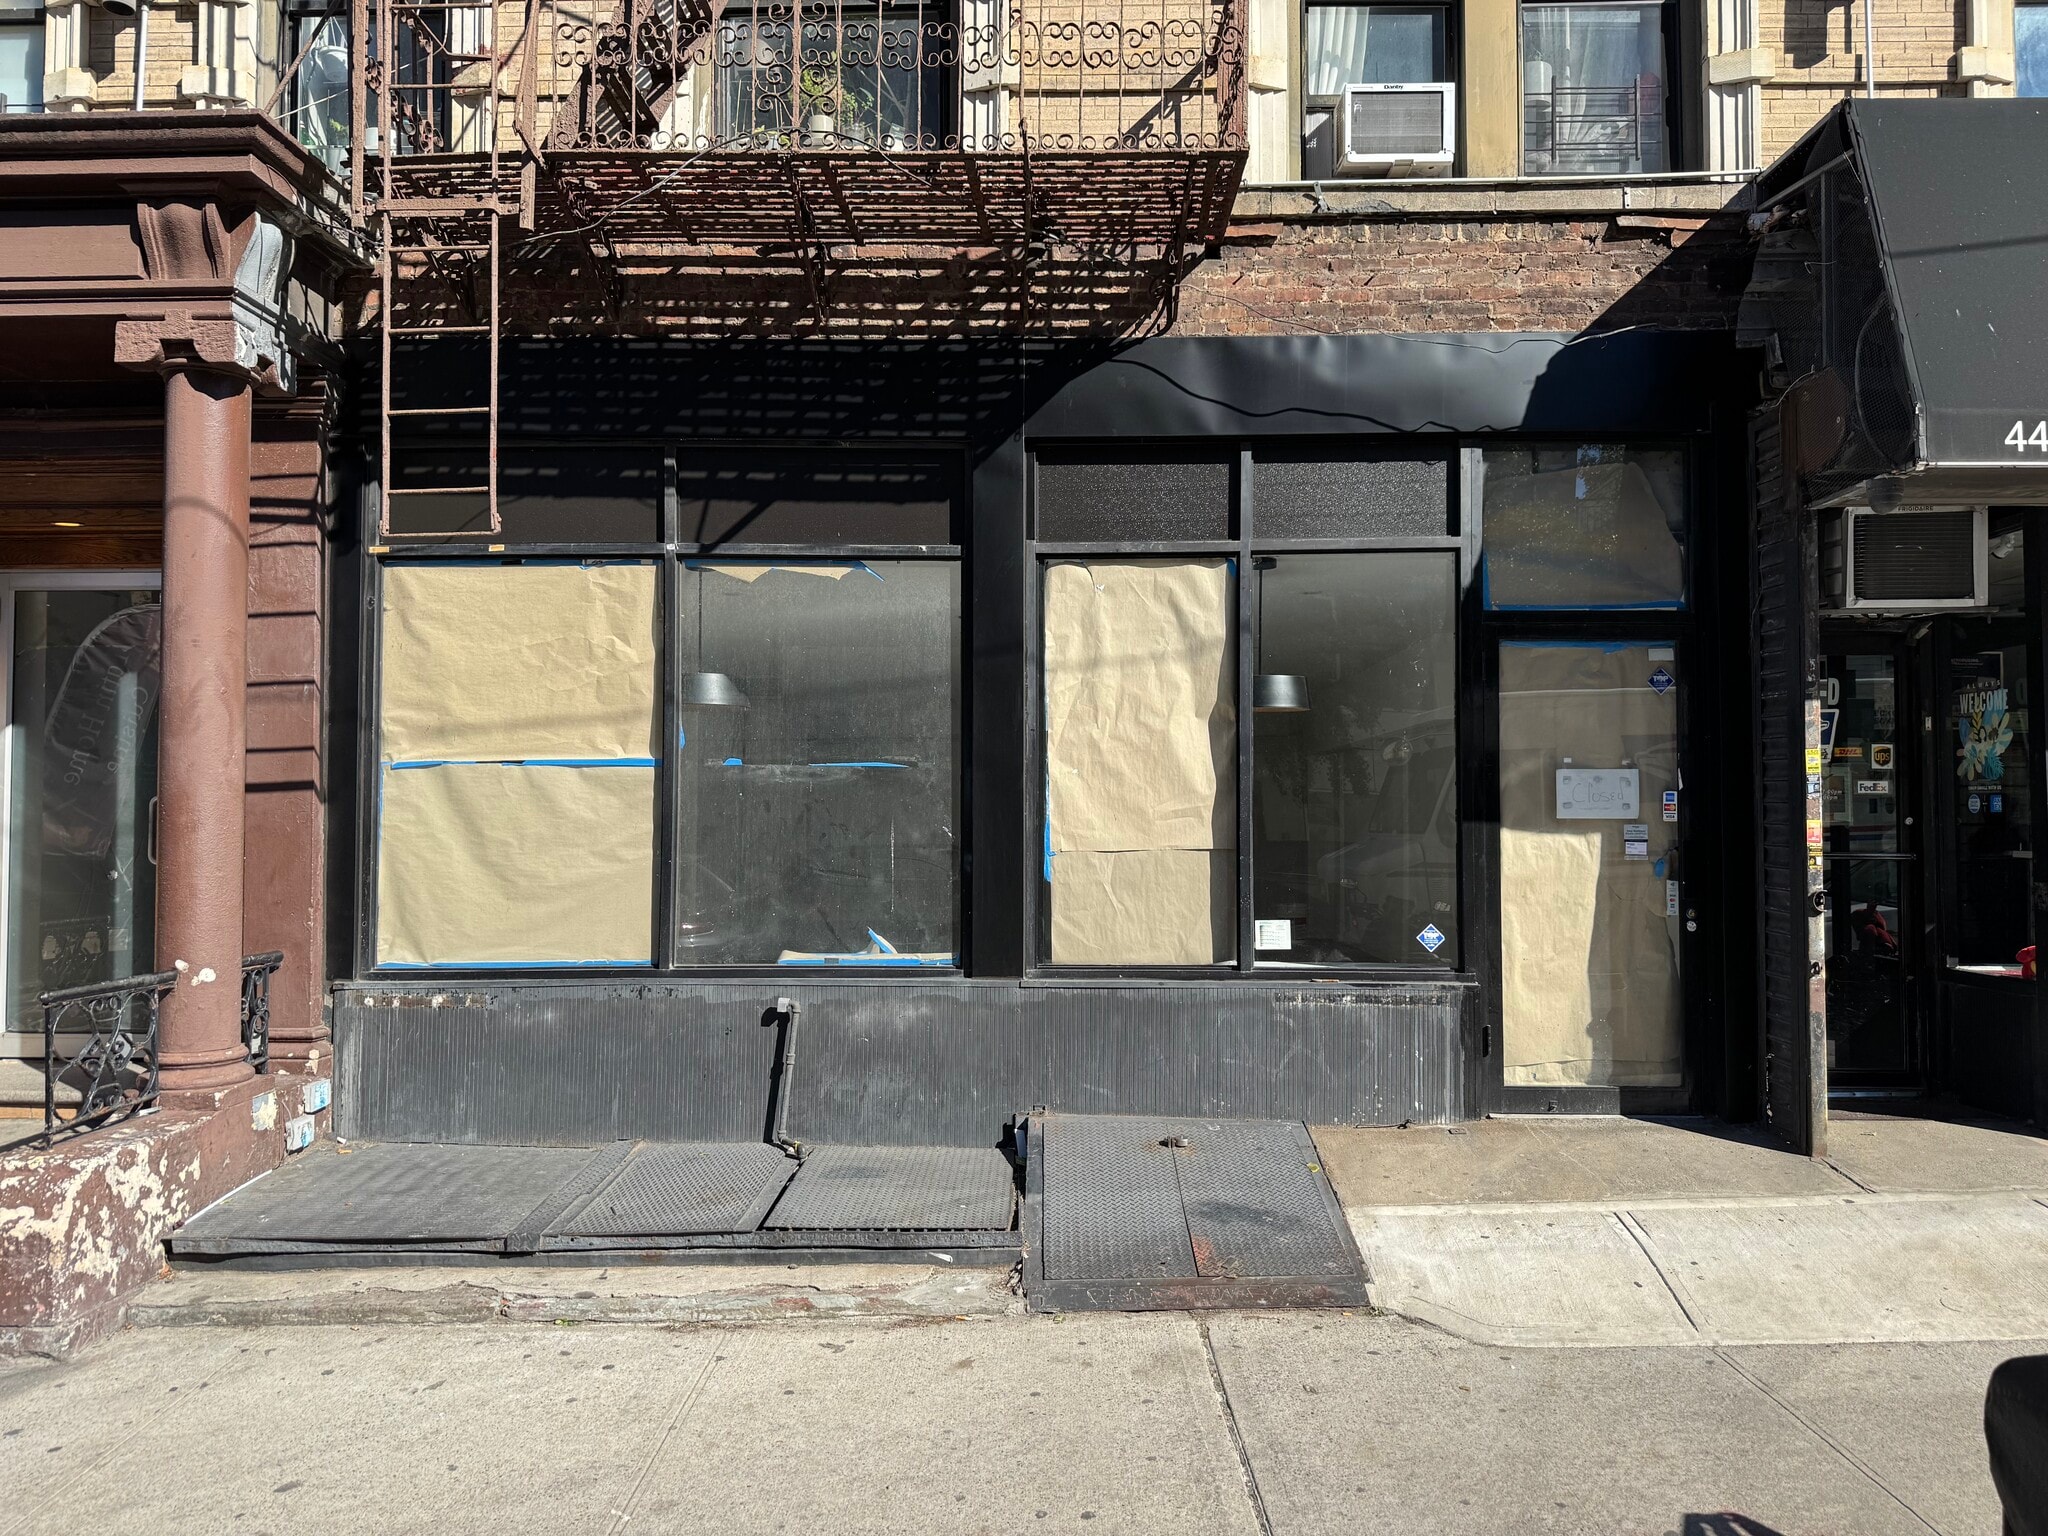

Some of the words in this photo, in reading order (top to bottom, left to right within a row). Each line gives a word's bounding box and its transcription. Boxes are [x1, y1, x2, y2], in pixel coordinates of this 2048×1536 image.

[1966, 680, 2001, 689] ALWAYS
[1959, 688, 2010, 714] WELCOME
[1874, 752, 1890, 764] ups
[1572, 778, 1624, 803] Closed
[1859, 782, 1887, 792] FedEx
